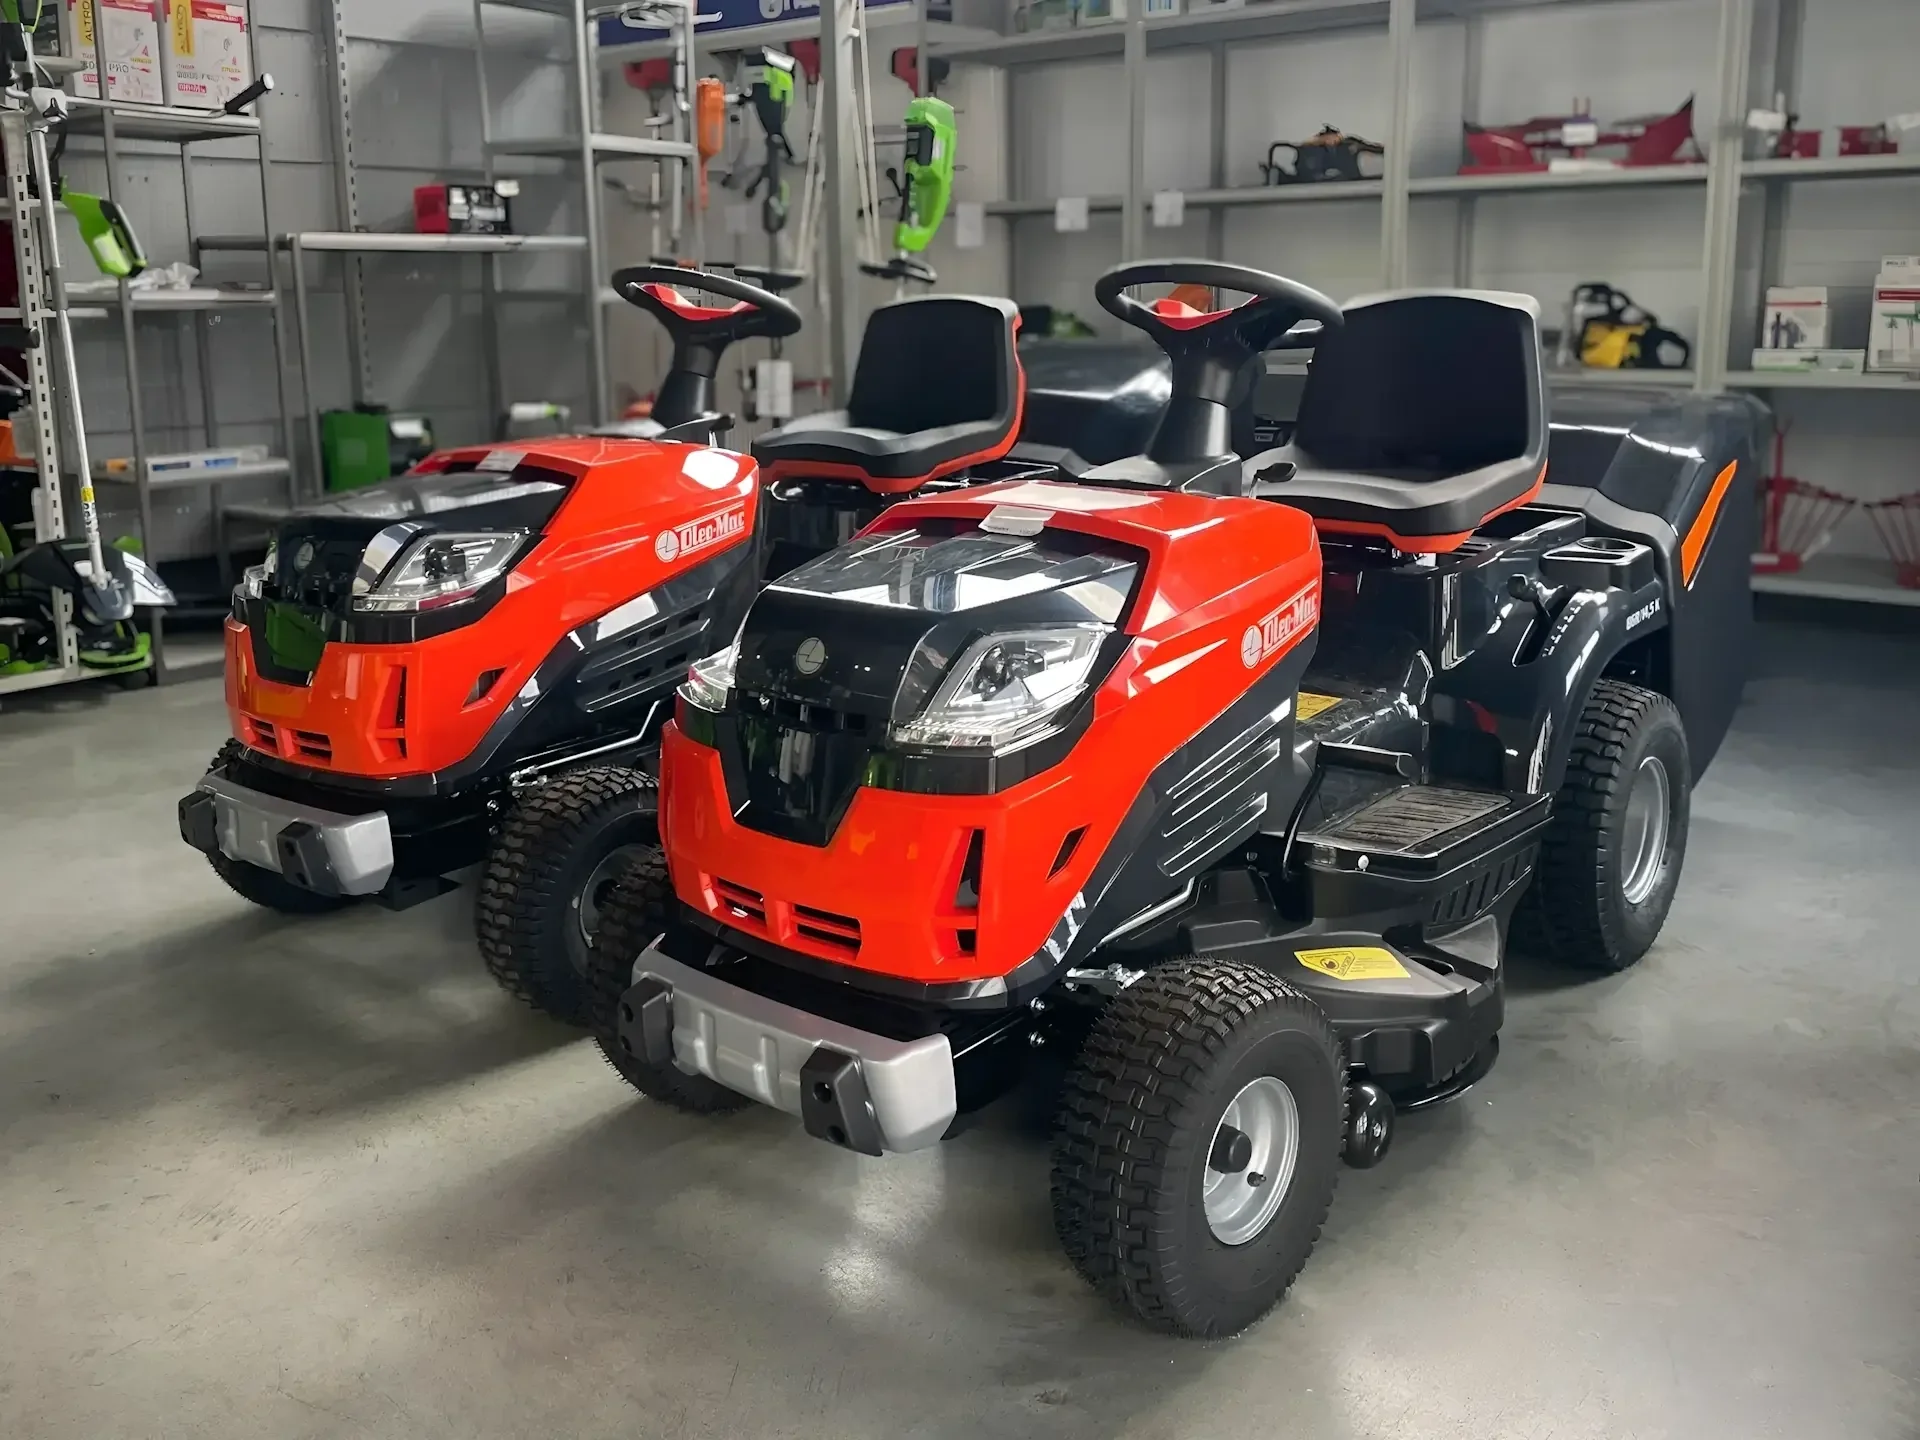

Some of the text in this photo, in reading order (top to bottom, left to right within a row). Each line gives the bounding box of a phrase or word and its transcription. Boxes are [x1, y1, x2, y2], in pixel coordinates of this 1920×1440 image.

[82, 1, 93, 41] ALTRO
[680, 512, 745, 551] Oleo-Mac
[1263, 592, 1317, 652] Oleo-Mac
